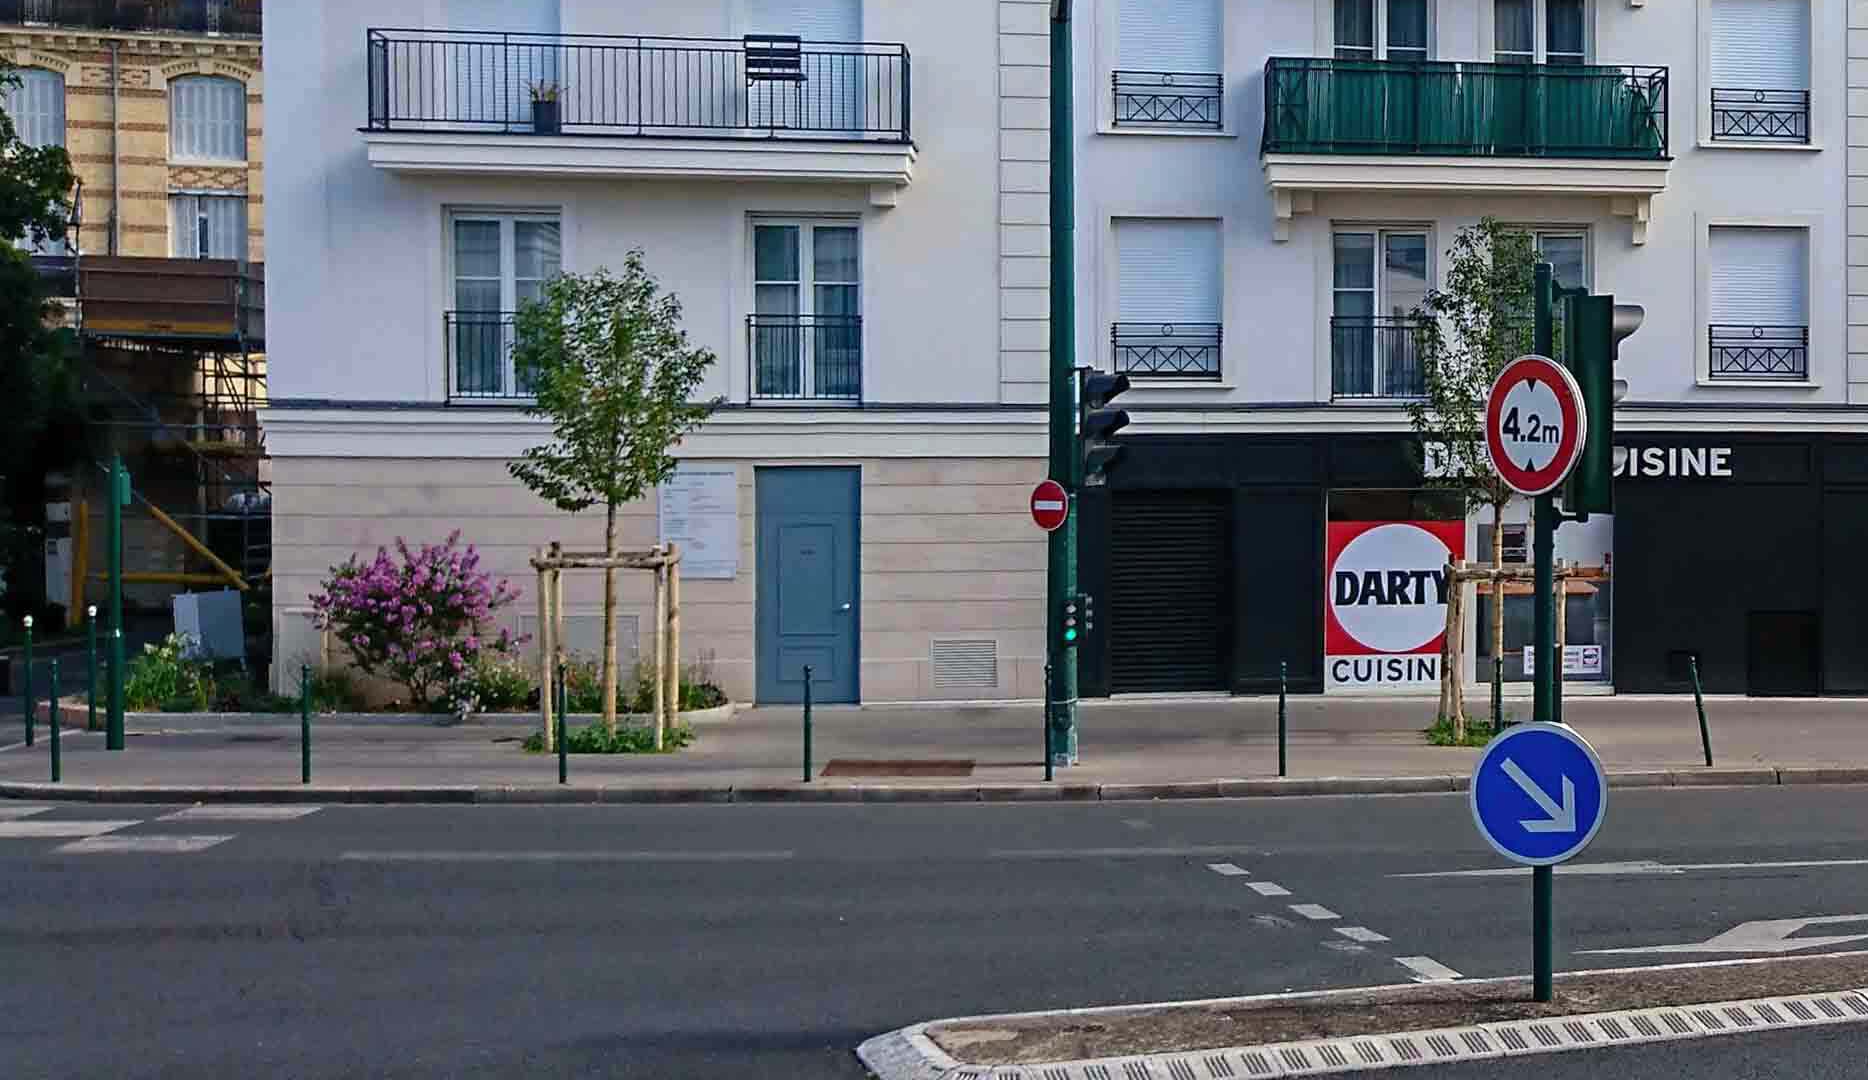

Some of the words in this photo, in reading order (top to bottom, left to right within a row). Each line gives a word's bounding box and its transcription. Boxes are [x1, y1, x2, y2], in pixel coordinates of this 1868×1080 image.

[1503, 407, 1559, 444] 4.2m
[1613, 447, 1733, 477] ISINE
[1335, 569, 1450, 605] DARTY
[1332, 658, 1436, 682] CUISIN
